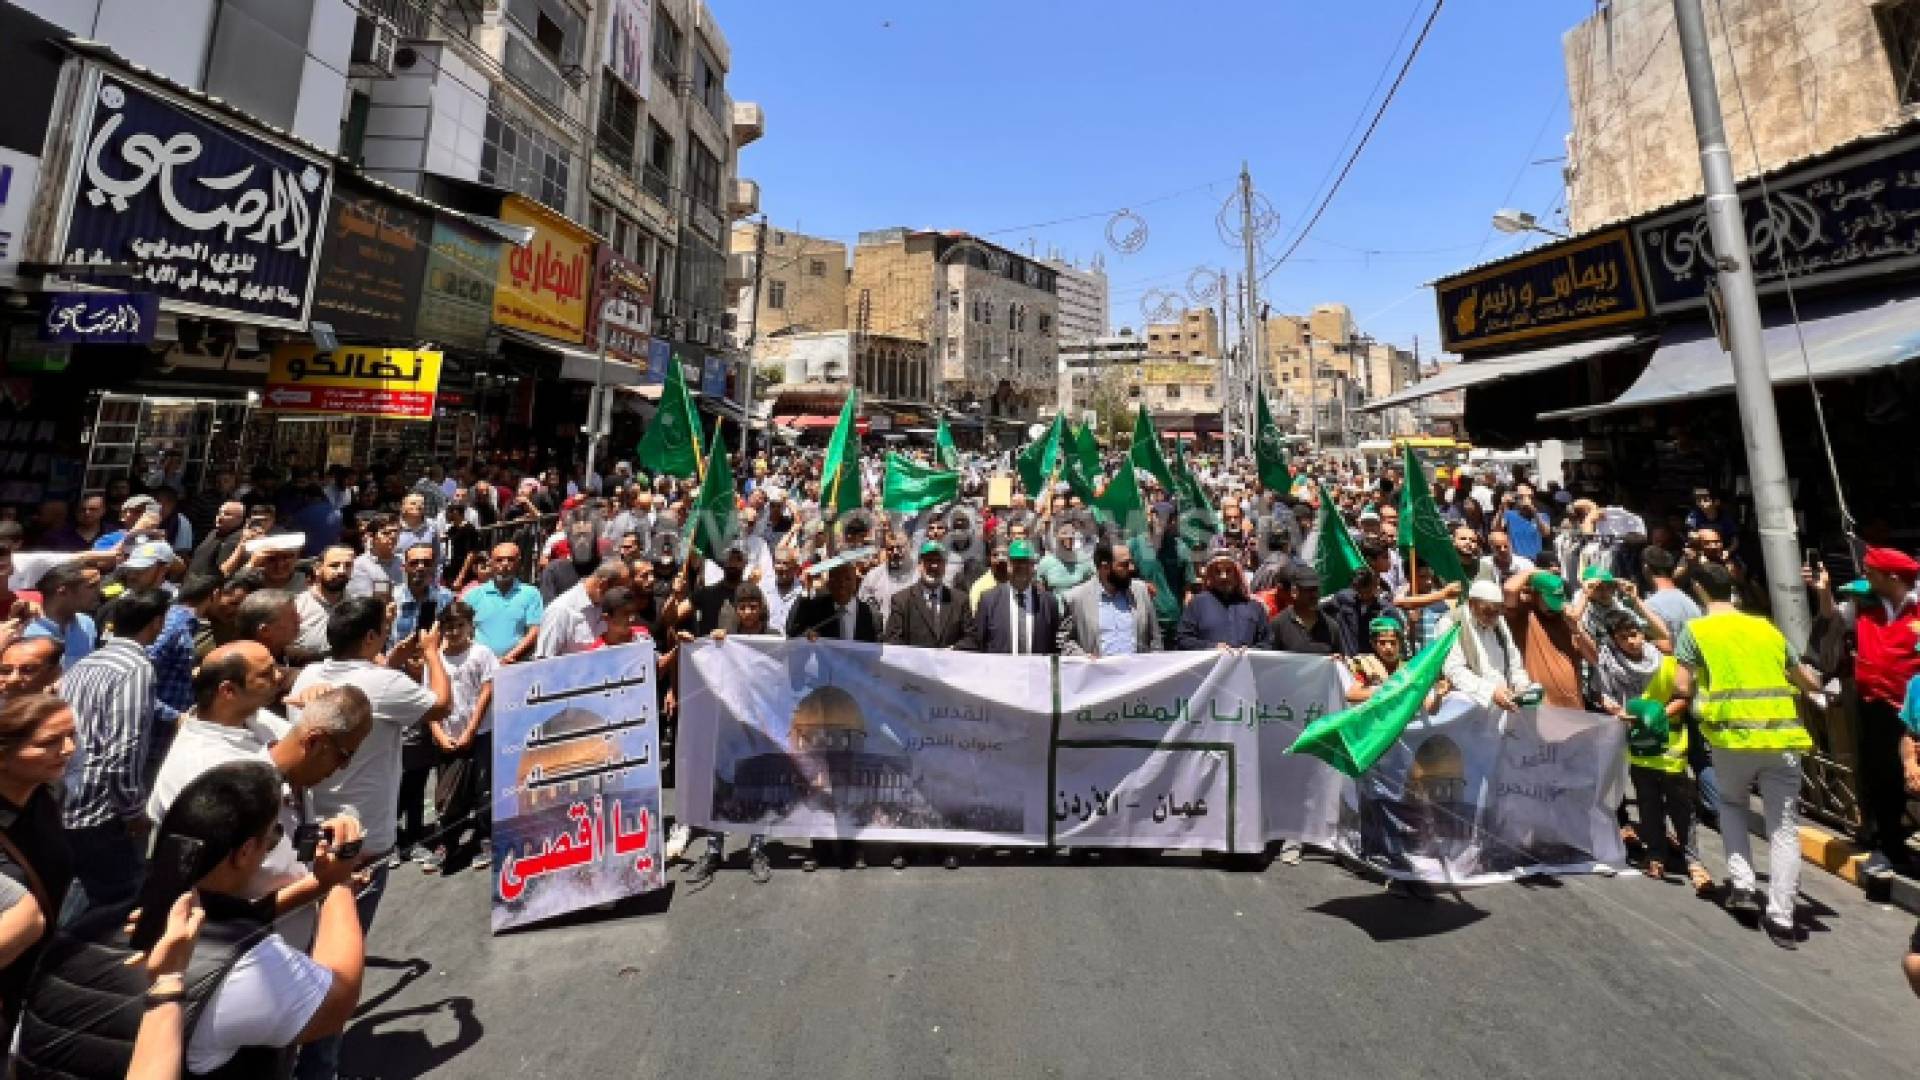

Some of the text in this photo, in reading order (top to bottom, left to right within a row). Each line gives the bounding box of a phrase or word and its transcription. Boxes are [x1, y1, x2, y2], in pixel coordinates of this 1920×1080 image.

[526, 664, 646, 705] لبيك
[526, 705, 647, 748] لبيك
[925, 703, 992, 724] القدس
[527, 744, 649, 789] لبيك
[1055, 785, 1119, 821] الأردن
[1152, 789, 1208, 824] عمان
[612, 800, 655, 873] يا
